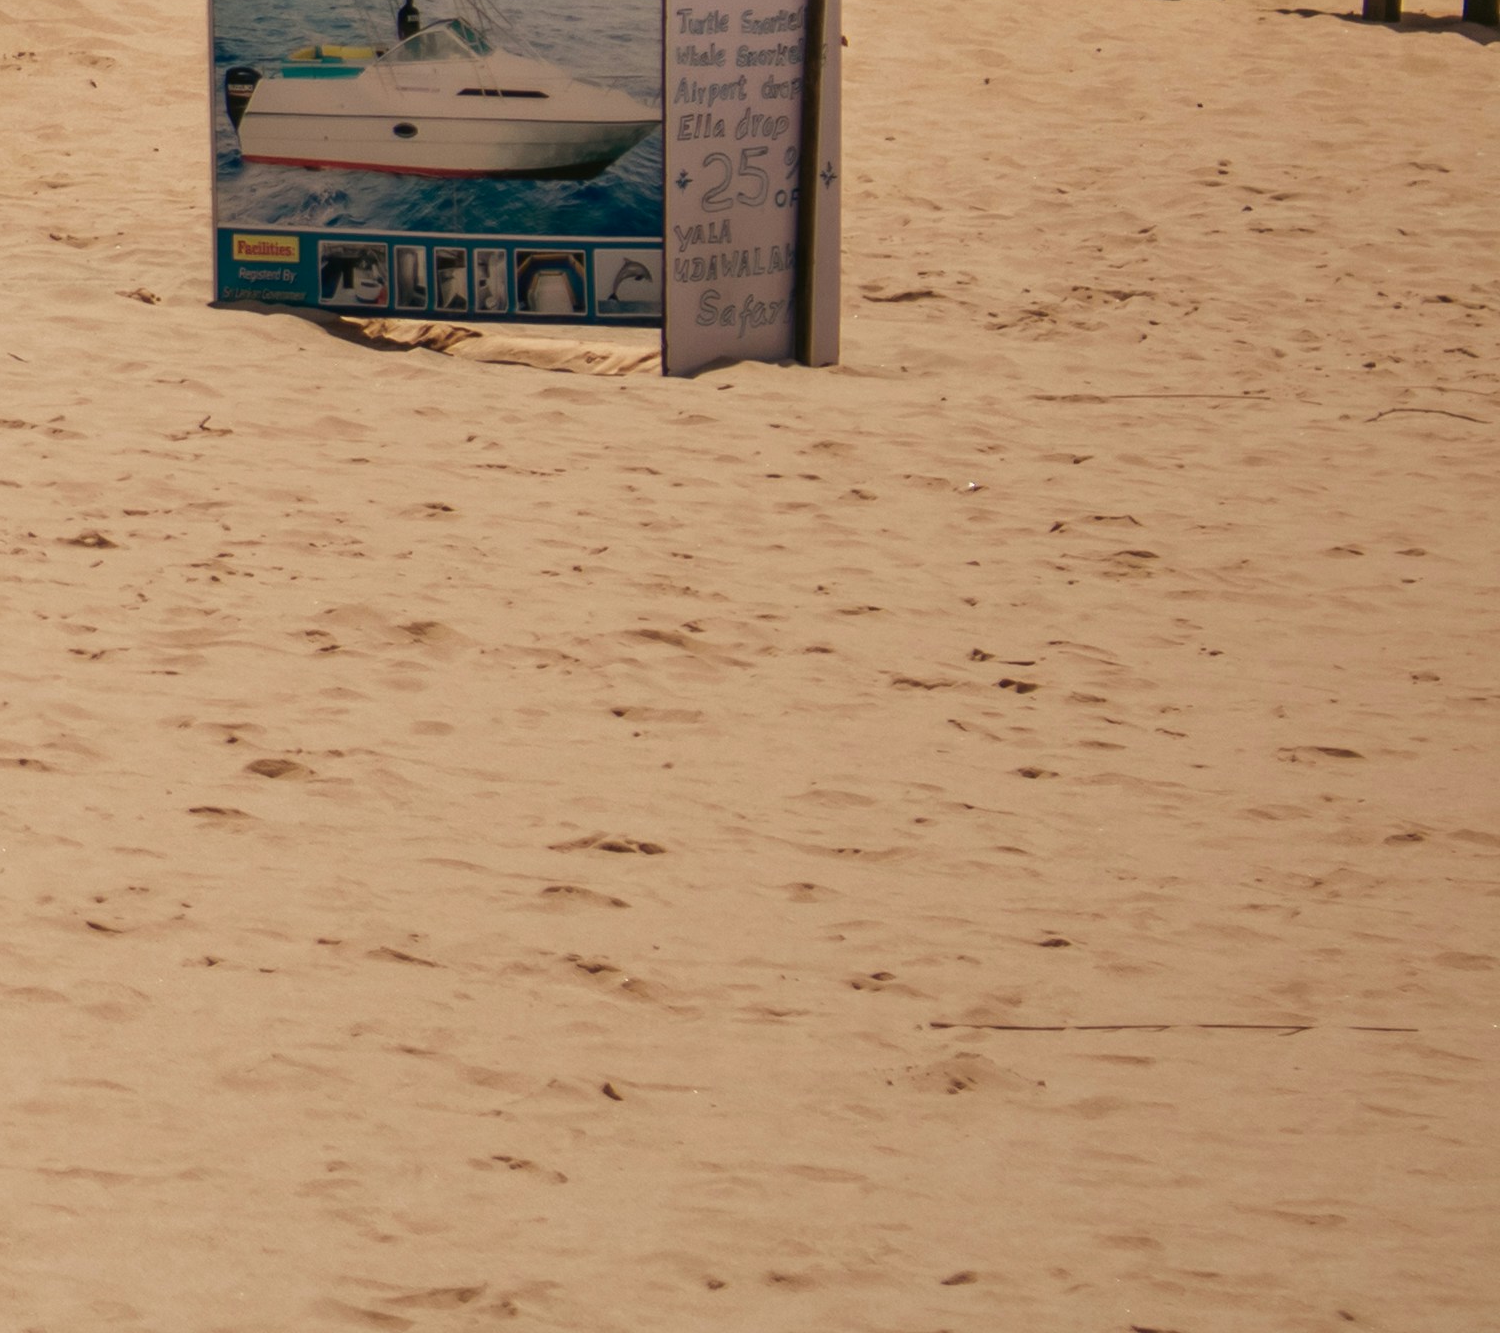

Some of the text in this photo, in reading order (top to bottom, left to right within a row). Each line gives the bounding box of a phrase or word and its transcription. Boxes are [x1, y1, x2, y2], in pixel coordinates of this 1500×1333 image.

[677, 109, 790, 141] Ella drop
[238, 240, 295, 256] Facilities:
[674, 219, 732, 253] YALA
